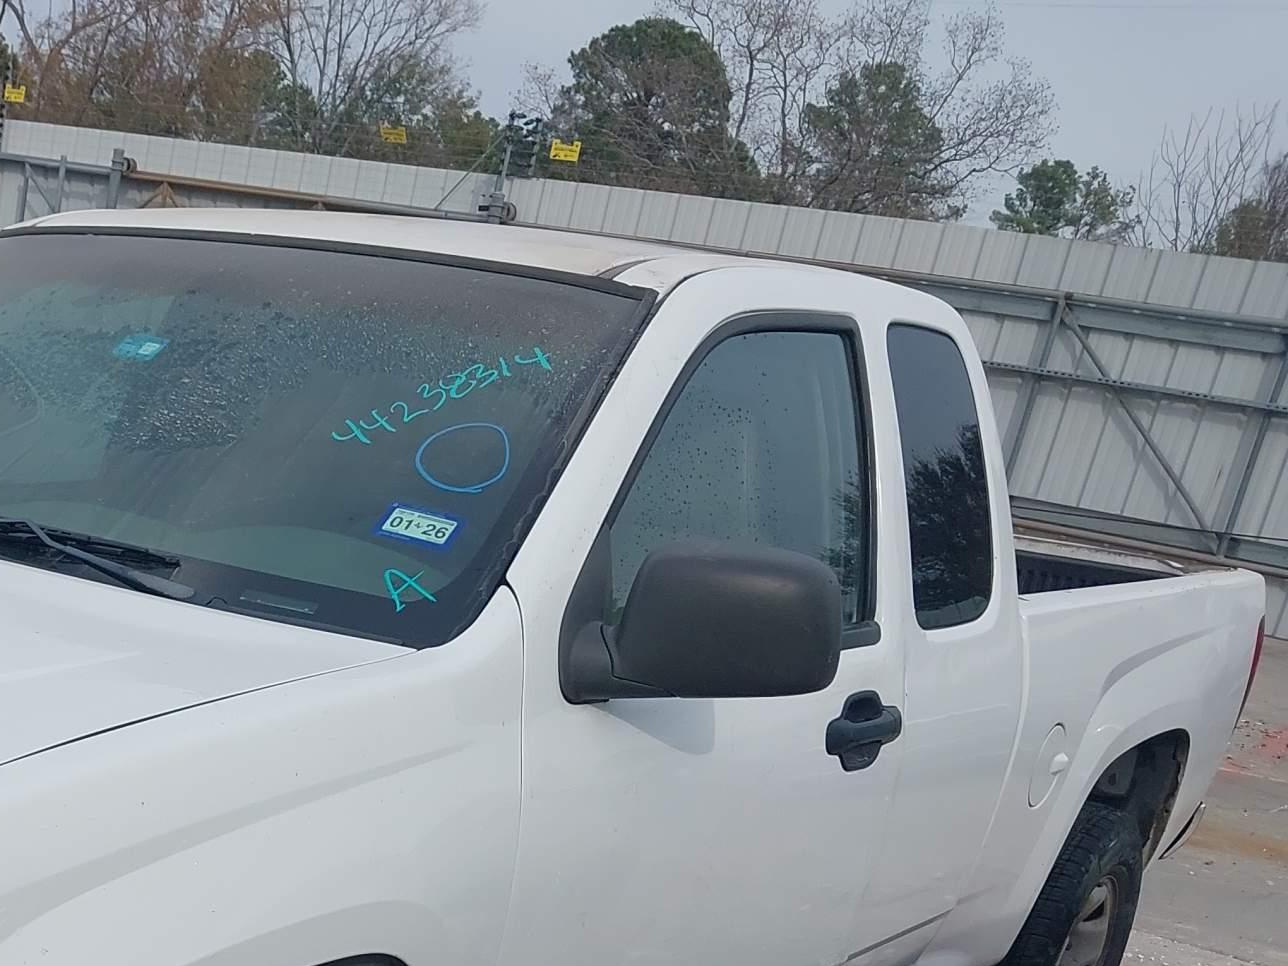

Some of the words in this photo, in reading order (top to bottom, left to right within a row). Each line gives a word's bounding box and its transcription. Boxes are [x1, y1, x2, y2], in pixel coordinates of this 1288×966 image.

[331, 347, 554, 445] 44238314
[389, 515, 415, 532] 01
[420, 523, 450, 540] 26
[383, 568, 438, 612] A
